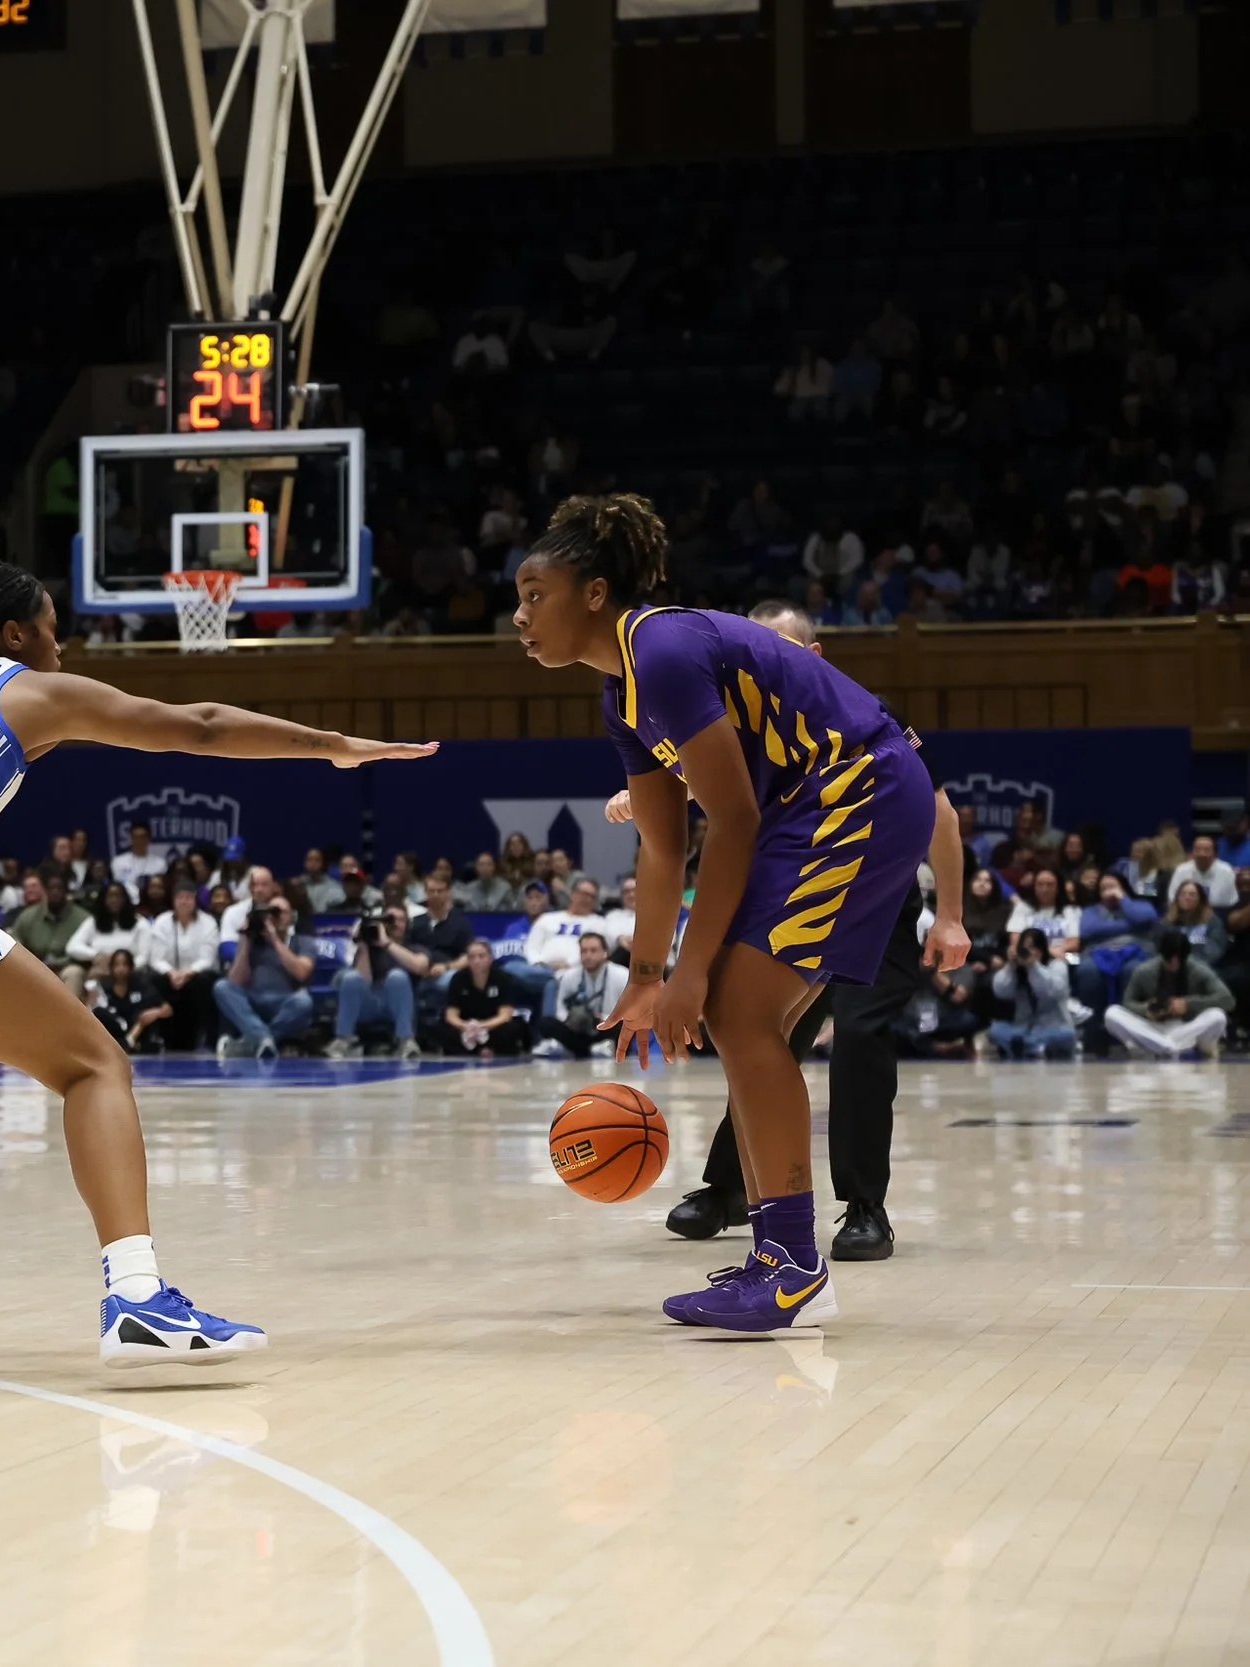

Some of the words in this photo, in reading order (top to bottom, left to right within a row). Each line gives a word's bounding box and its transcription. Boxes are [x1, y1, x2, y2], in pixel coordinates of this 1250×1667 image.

[200, 333, 271, 369] 5:28
[190, 370, 262, 429] 24
[651, 737, 680, 769] SU
[118, 817, 229, 848] STERHOOD
[755, 1250, 778, 1267] LSU
